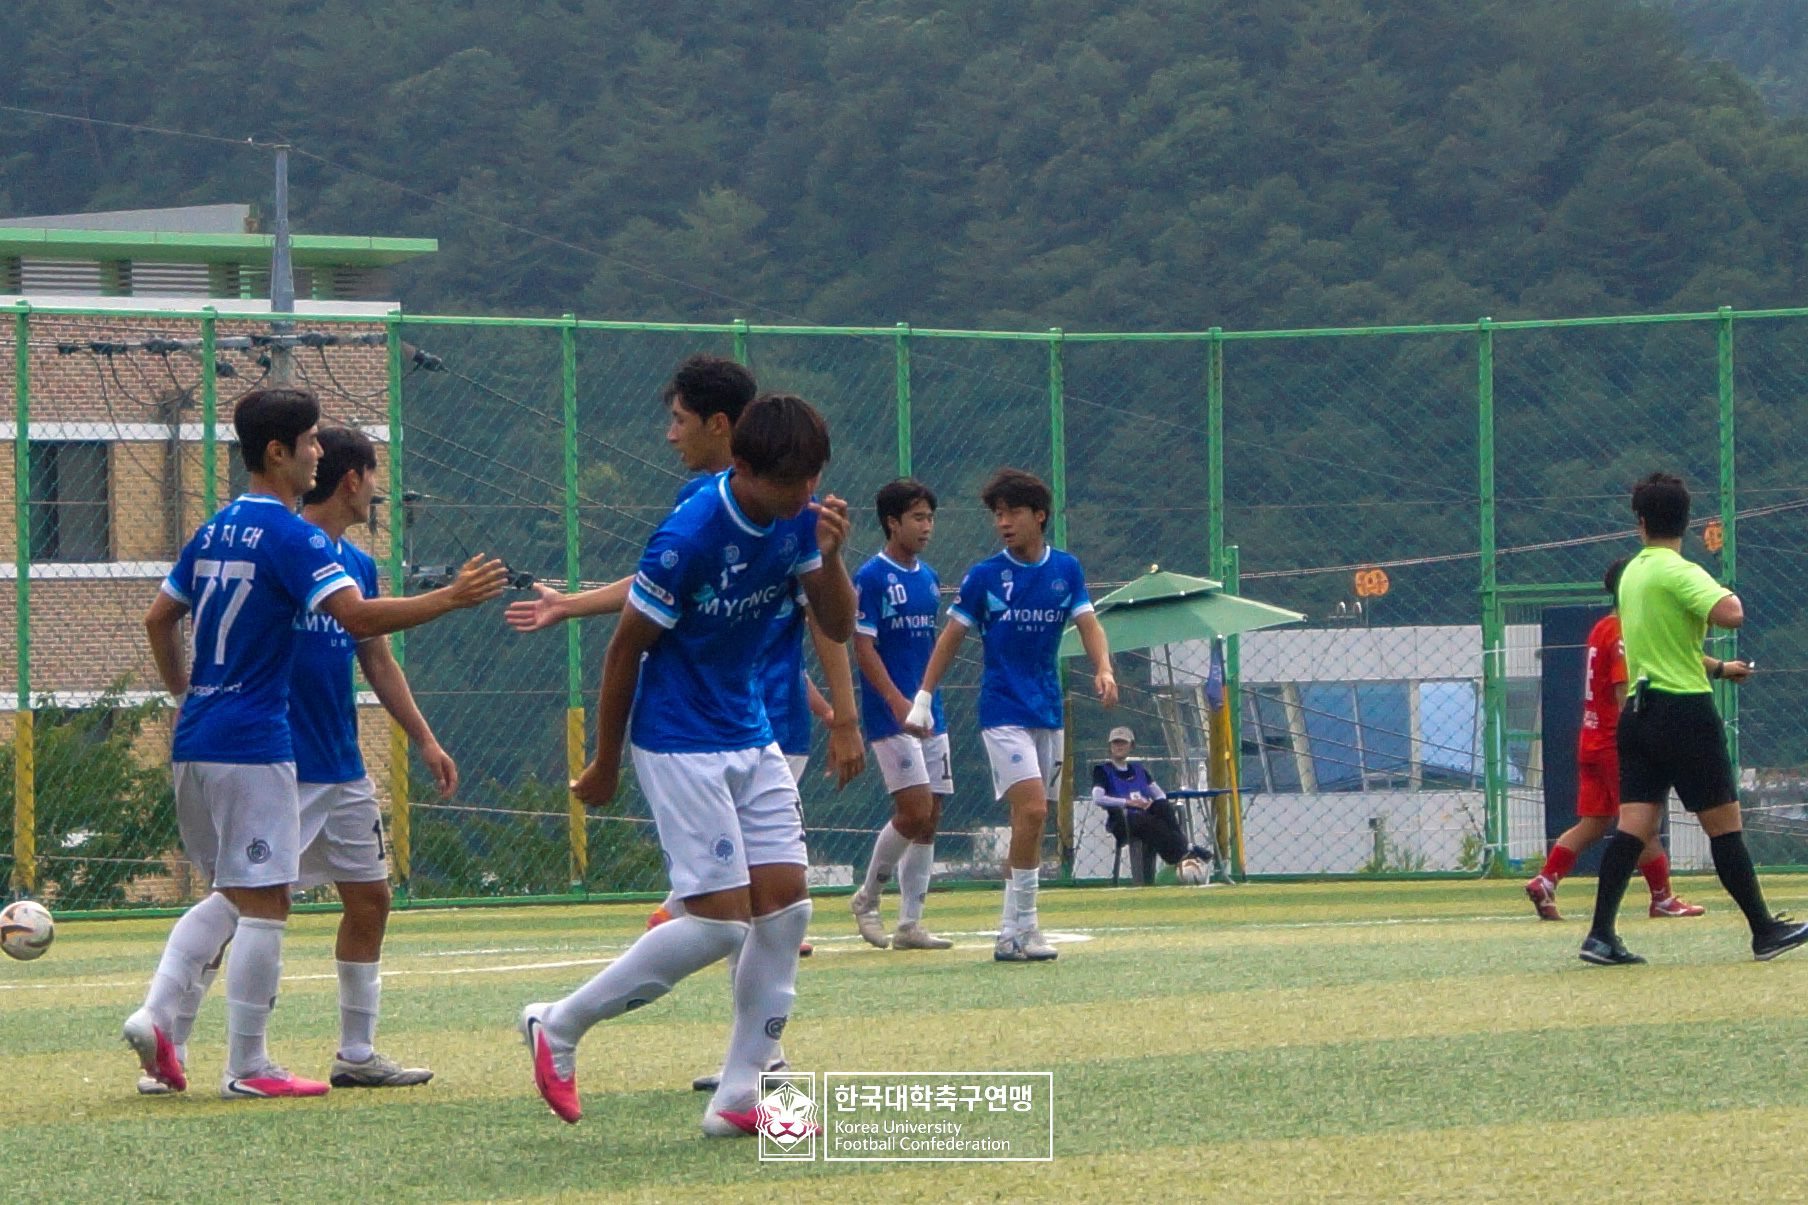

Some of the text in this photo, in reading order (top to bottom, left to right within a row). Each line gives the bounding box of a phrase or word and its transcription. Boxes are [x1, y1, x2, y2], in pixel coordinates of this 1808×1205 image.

[887, 583, 907, 605] 10
[1002, 581, 1014, 601] 7
[192, 559, 256, 666] 77
